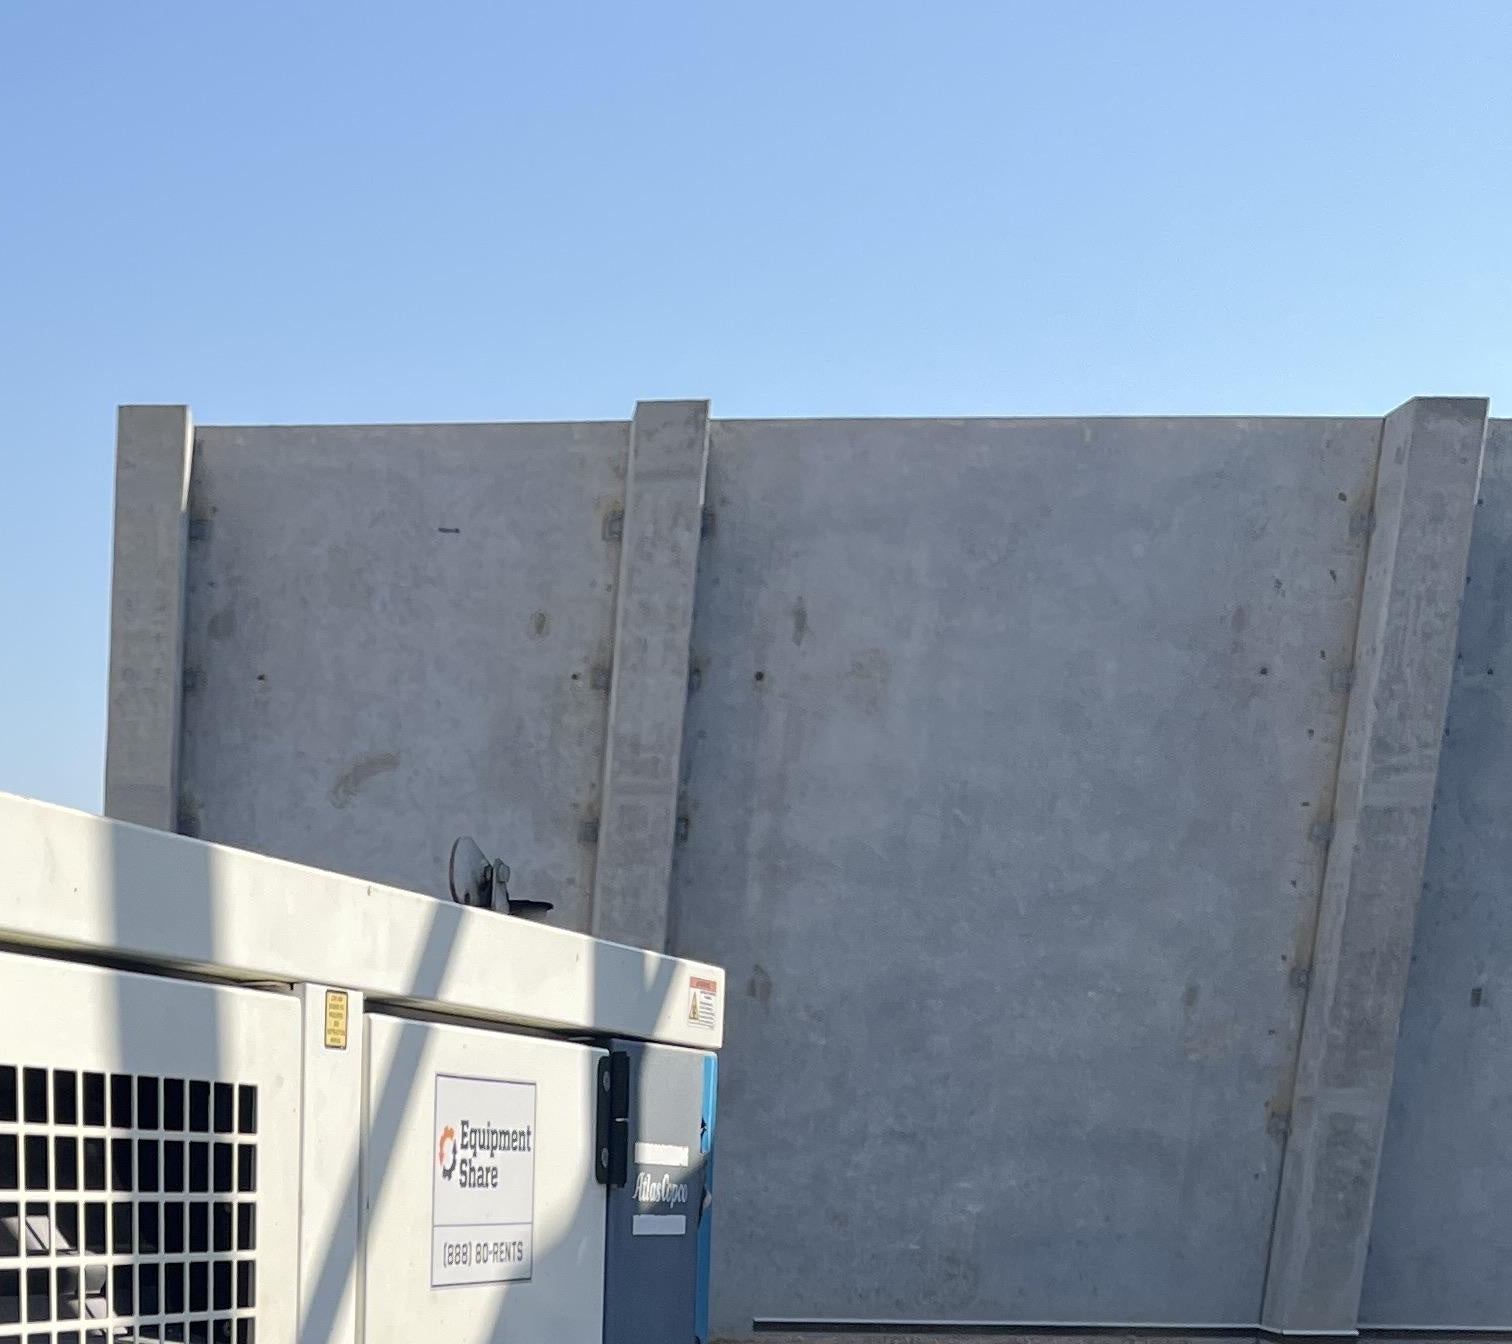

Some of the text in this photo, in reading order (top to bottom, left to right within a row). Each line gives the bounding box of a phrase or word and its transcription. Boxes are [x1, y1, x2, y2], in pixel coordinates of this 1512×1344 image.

[460, 1120, 531, 1158] Equipment
[459, 1159, 499, 1189] Share
[632, 1171, 661, 1202] Atlas
[443, 1241, 523, 1268] (888) 80-RENTS
